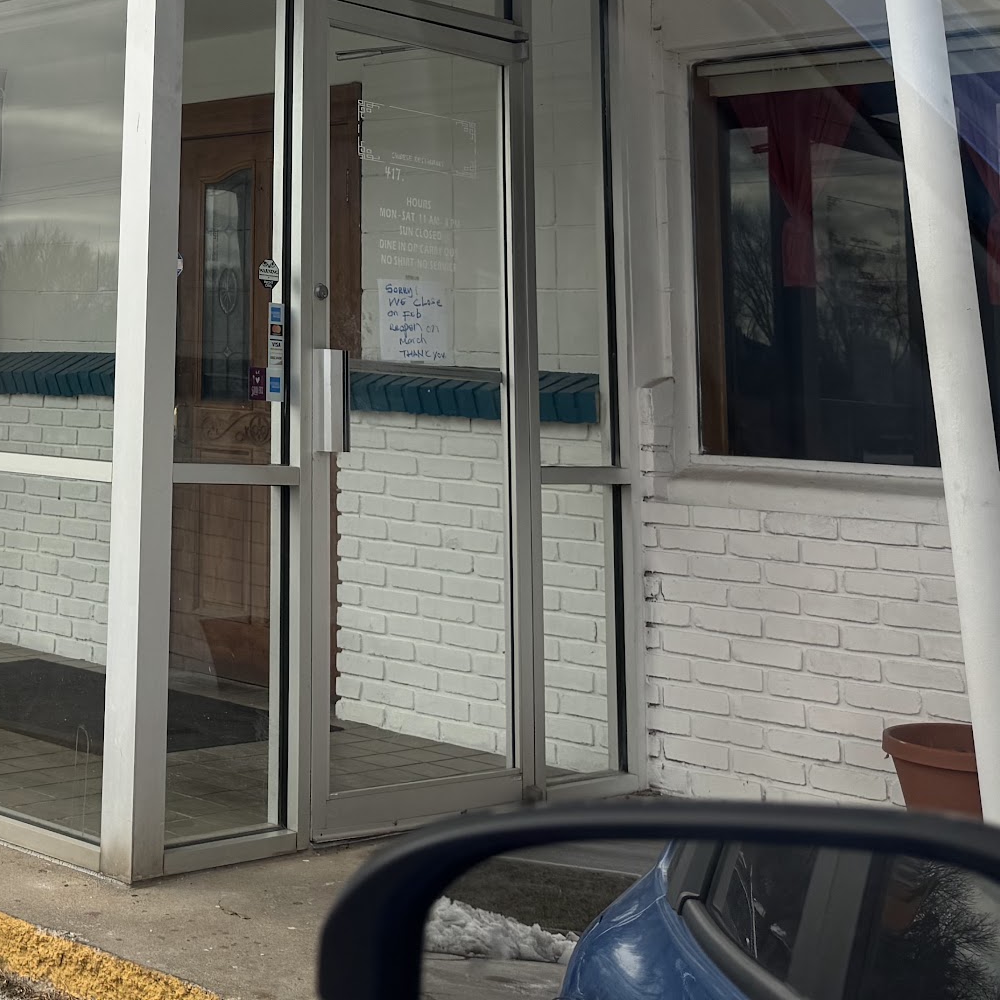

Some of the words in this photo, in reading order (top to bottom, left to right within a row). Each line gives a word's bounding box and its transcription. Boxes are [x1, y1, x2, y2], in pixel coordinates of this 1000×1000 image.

[406, 197, 432, 210] HOURS
[399, 225, 413, 236] SUN
[415, 228, 441, 240] CLOSED
[379, 239, 397, 251] DINE
[398, 241, 406, 251] IN
[407, 242, 418, 252] OR
[380, 254, 392, 265] NO
